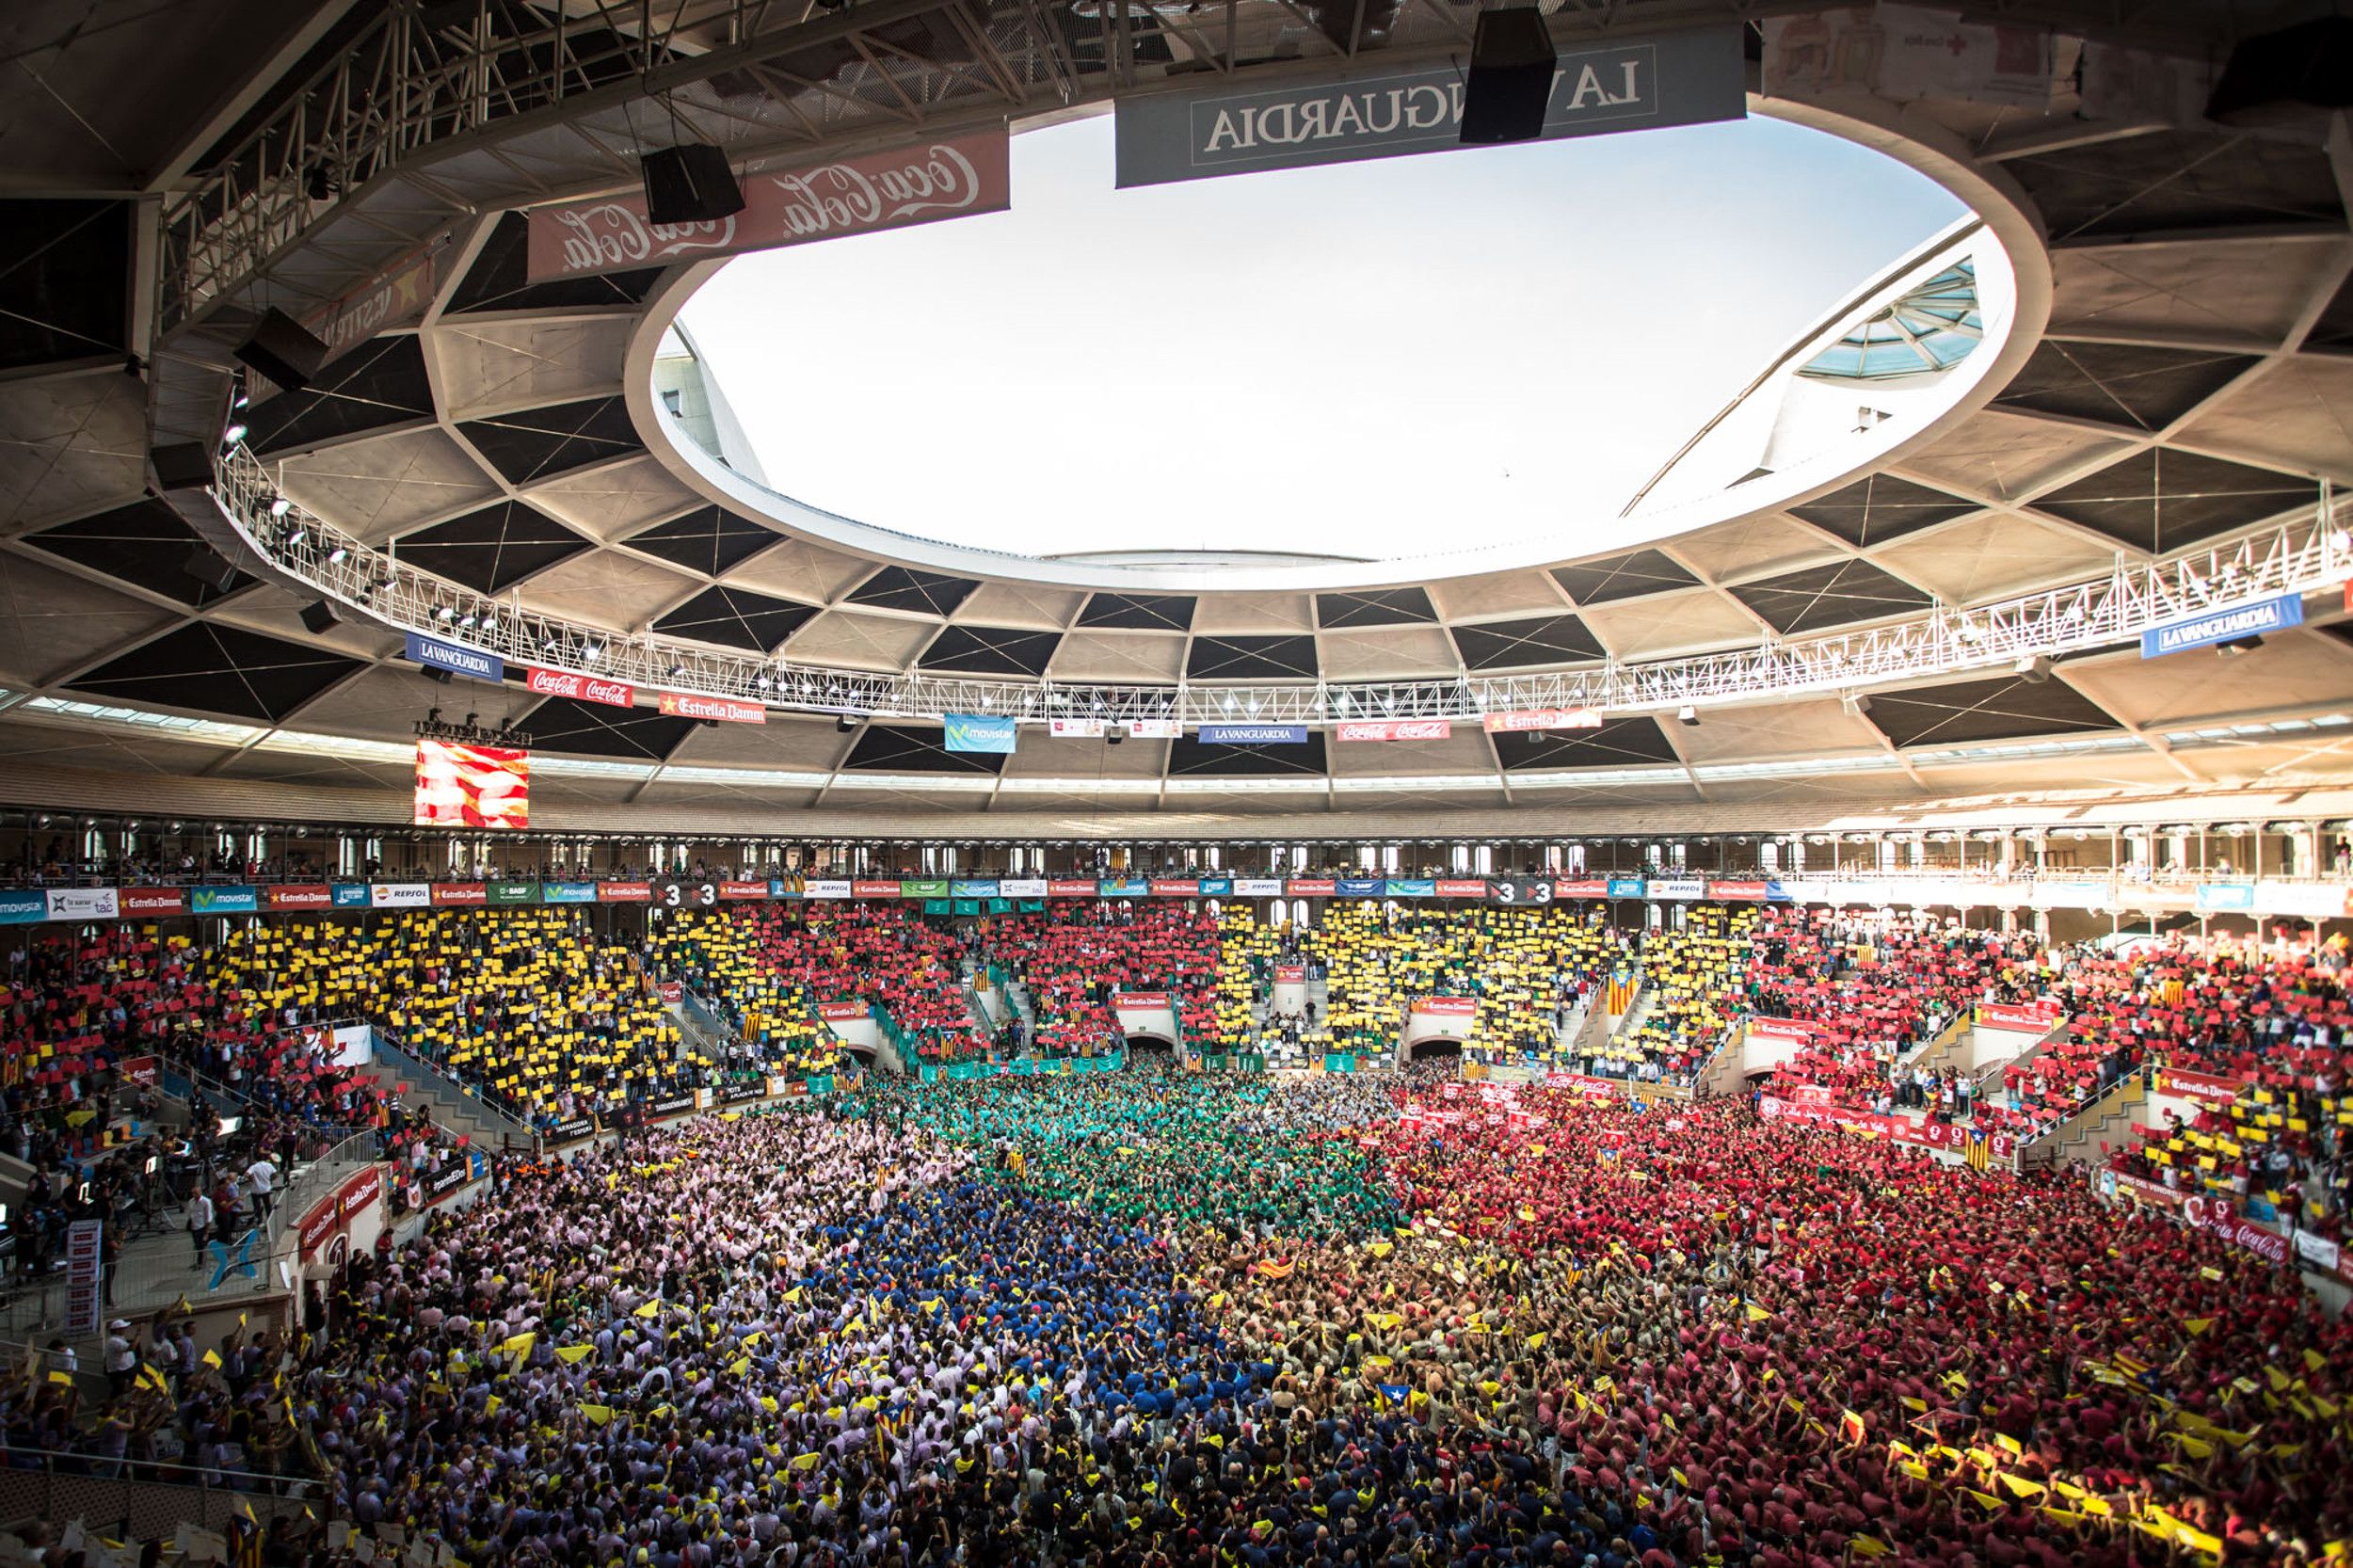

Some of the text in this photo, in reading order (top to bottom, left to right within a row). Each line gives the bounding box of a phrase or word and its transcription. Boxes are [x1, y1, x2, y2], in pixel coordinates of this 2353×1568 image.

[2162, 604, 2276, 648] LA VANGUARDIA
[421, 643, 490, 674] LA VANGUARDIA
[678, 697, 764, 722] Estrella Damm
[1506, 712, 1552, 728] Estrella
[968, 728, 1012, 739] movistar
[1214, 728, 1290, 739] LA VANGUARDIA
[216, 892, 252, 903] movistar
[280, 893, 309, 903] Estrella
[310, 892, 331, 902] Damm
[442, 890, 466, 899] Estrella
[563, 888, 594, 896] movistar
[607, 888, 631, 896] Estrella
[665, 884, 680, 906] 3
[700, 883, 715, 906] 3
[1498, 882, 1515, 904] 3
[1535, 882, 1551, 904] 3
[129, 898, 182, 908] Estrella Damm
[826, 1008, 850, 1016] Estrella
[2170, 1079, 2208, 1095] Estrella
